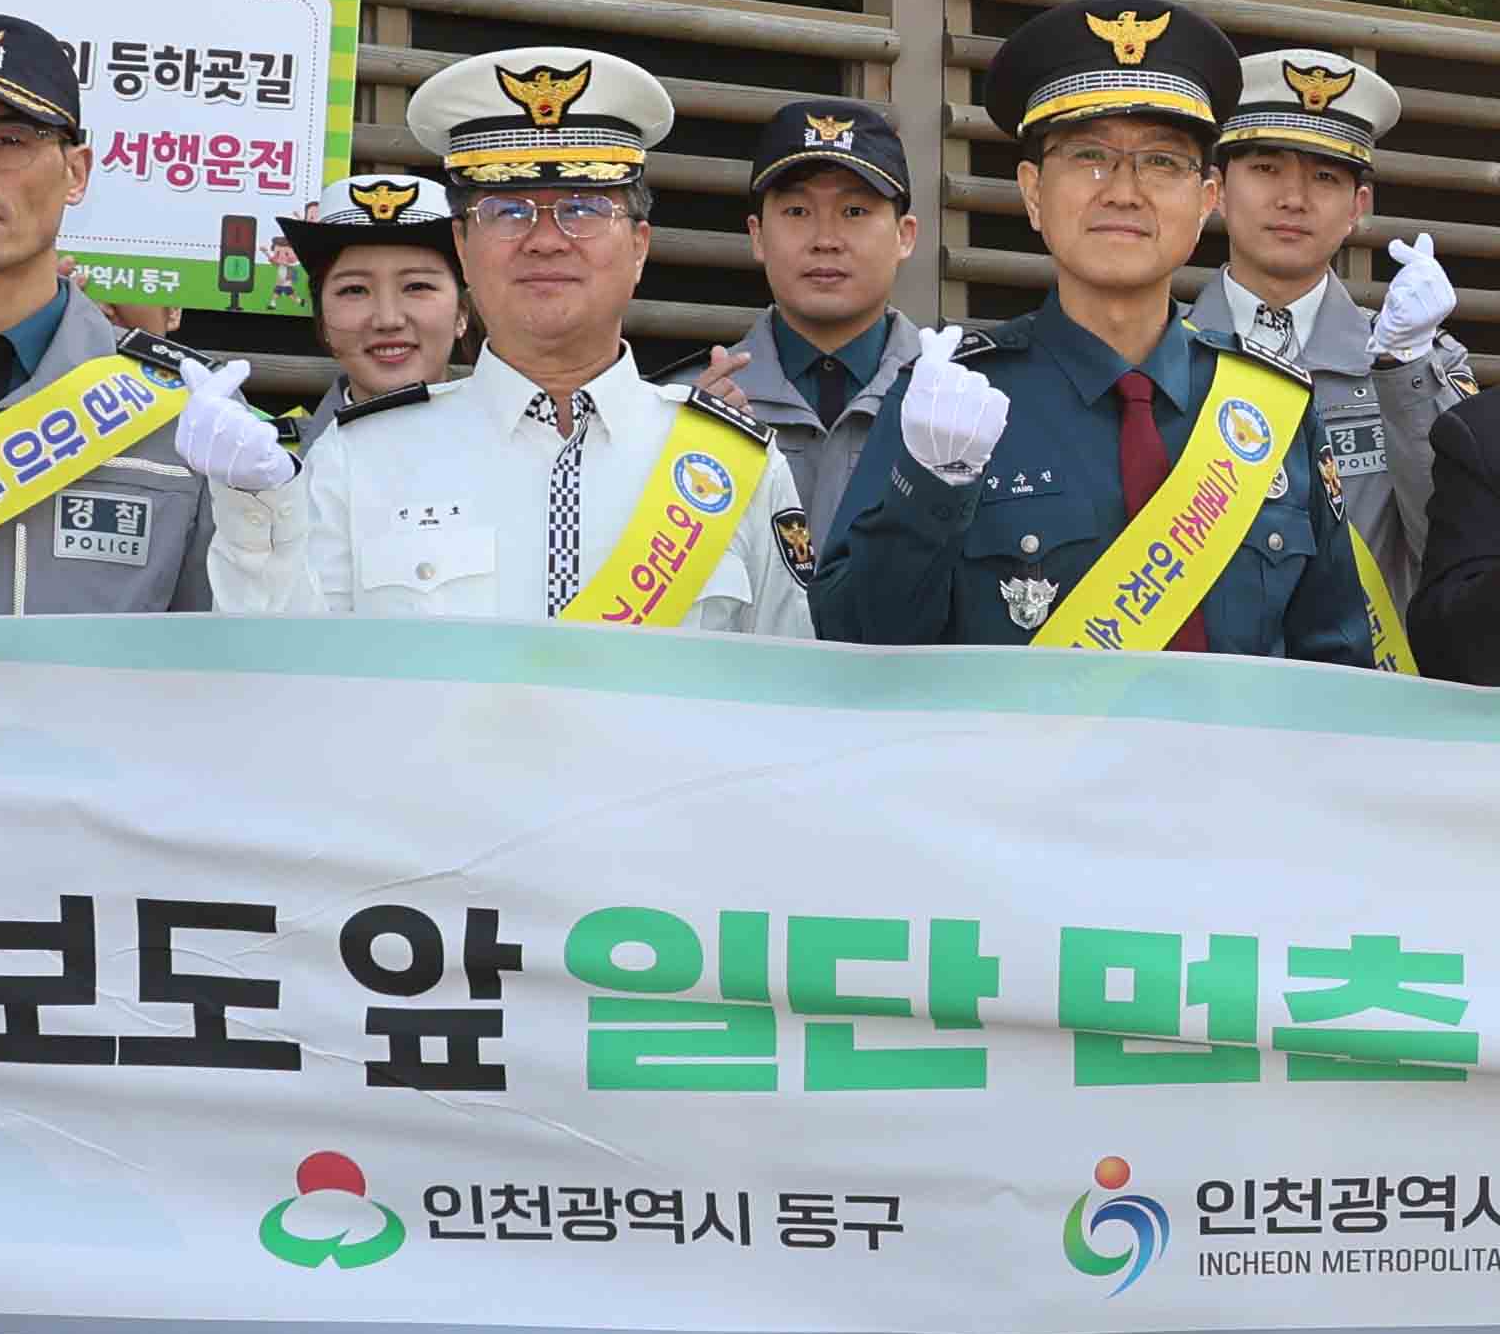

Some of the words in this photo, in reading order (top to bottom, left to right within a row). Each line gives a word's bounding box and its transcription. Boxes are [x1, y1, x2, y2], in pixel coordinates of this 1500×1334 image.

[106, 46, 293, 105] 등하굣길
[102, 131, 293, 191] 서행운전
[139, 268, 181, 292] 동구
[83, 373, 155, 436] 우리
[3, 409, 87, 485] 아이
[66, 496, 142, 536] 경찰
[1169, 458, 1240, 556] 스쿨존
[64, 535, 140, 556] POLICE
[1117, 540, 1185, 624] 안전
[338, 902, 523, 1092] 앞
[563, 905, 999, 1093] 일단
[422, 1182, 752, 1247] 인천광역시
[776, 1191, 905, 1251] 동구
[1198, 1250, 1314, 1277] INCHEON
